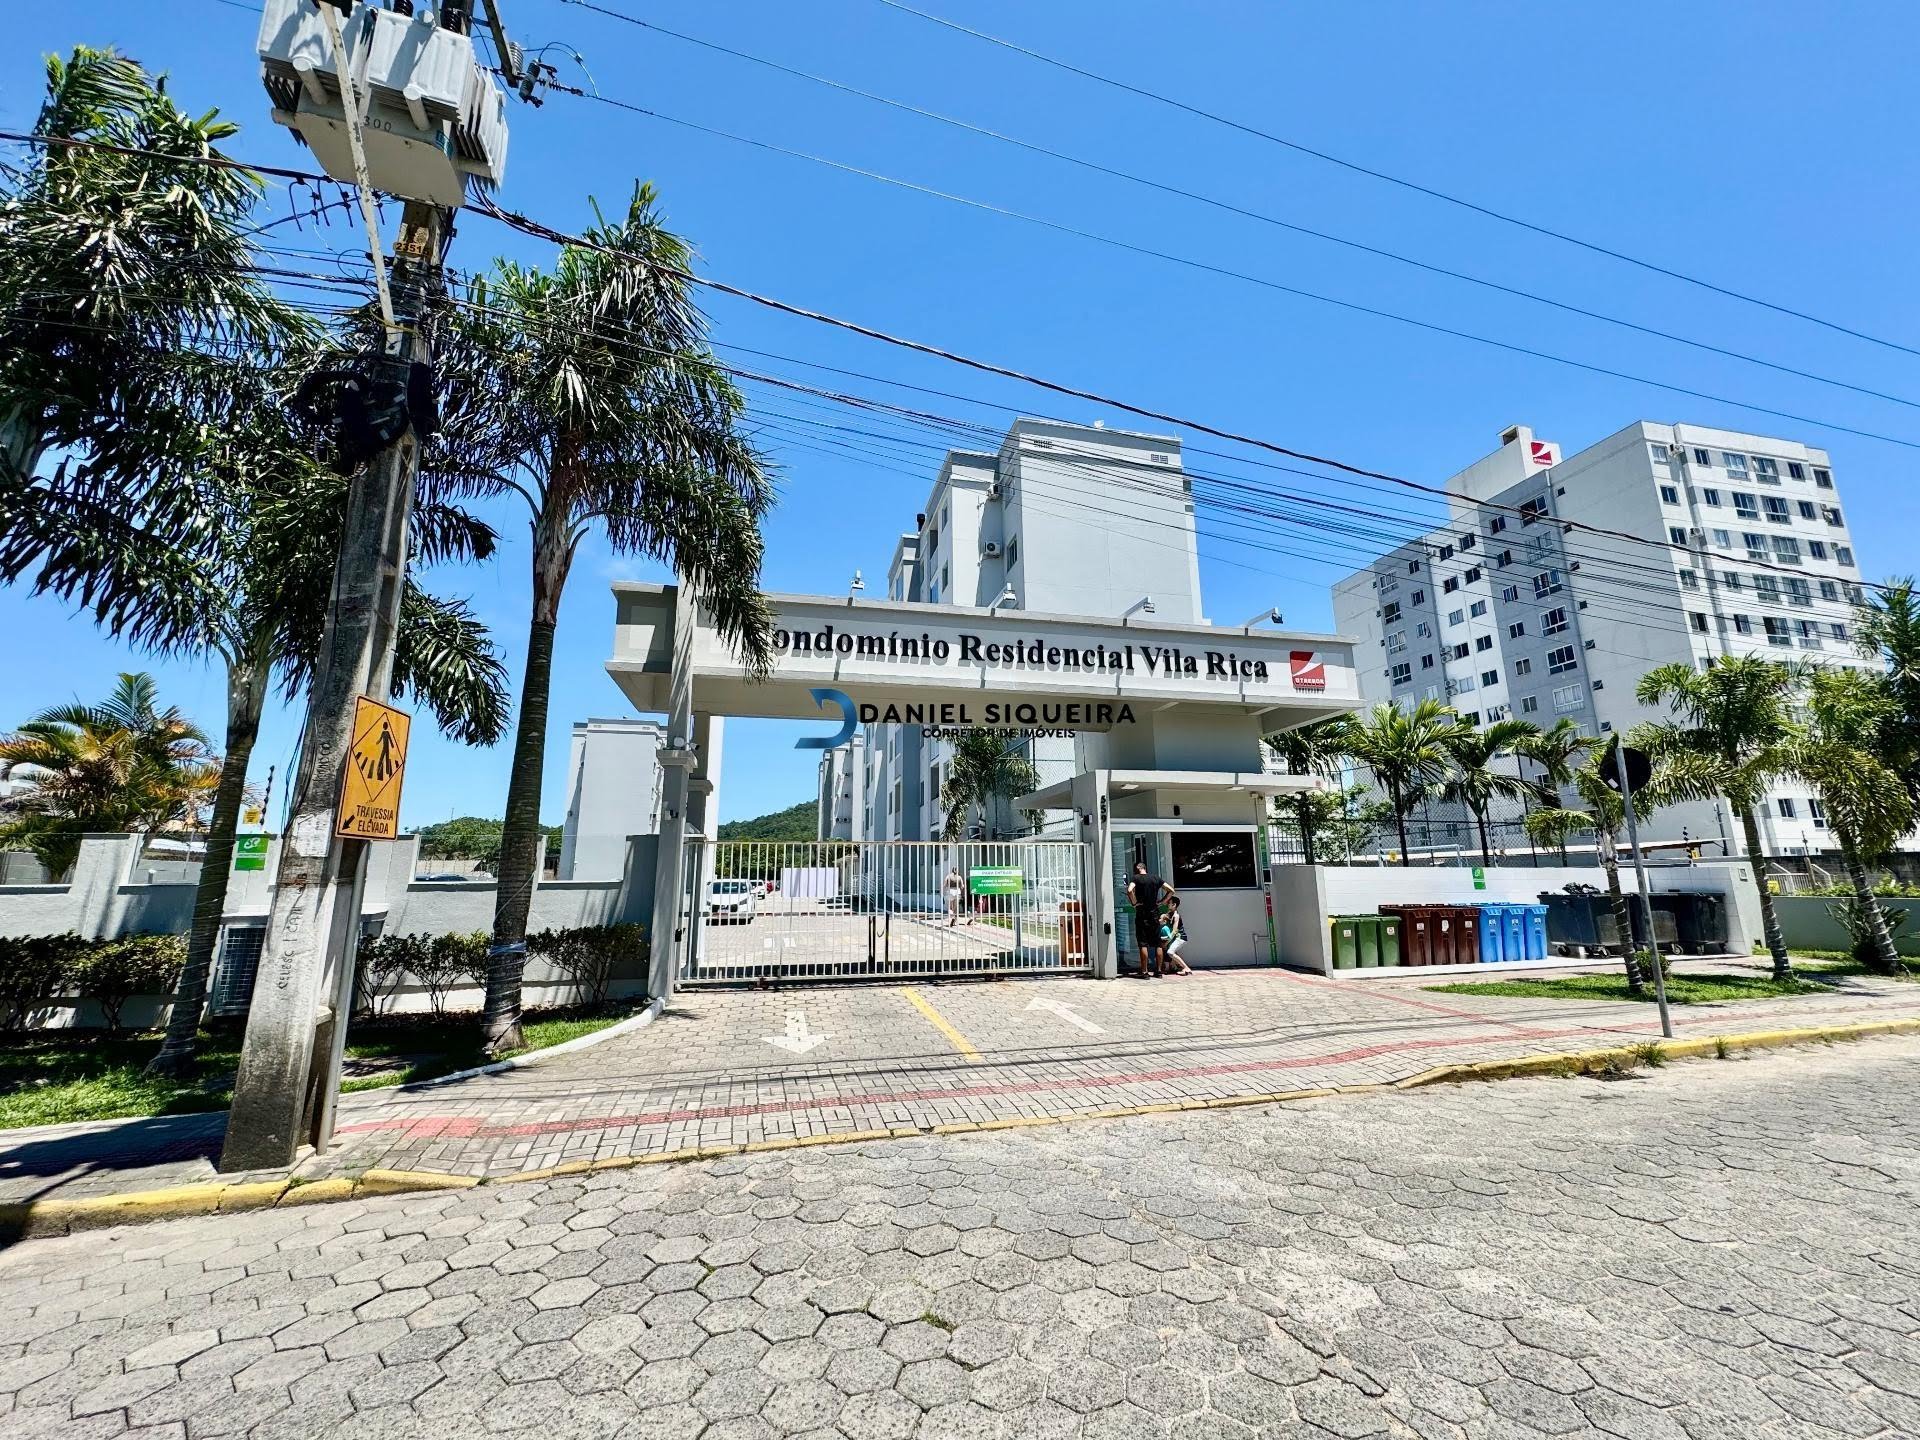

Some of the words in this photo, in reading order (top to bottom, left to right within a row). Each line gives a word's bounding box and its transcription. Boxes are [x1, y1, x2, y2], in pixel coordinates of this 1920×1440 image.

[364, 116, 391, 132] 300
[396, 243, 422, 253] 2351
[772, 625, 949, 659] ondomínio
[958, 634, 1134, 671] Residencial
[1140, 646, 1198, 673] Vila
[1204, 651, 1269, 678] Rica
[356, 805, 394, 821] TRAVESSIA
